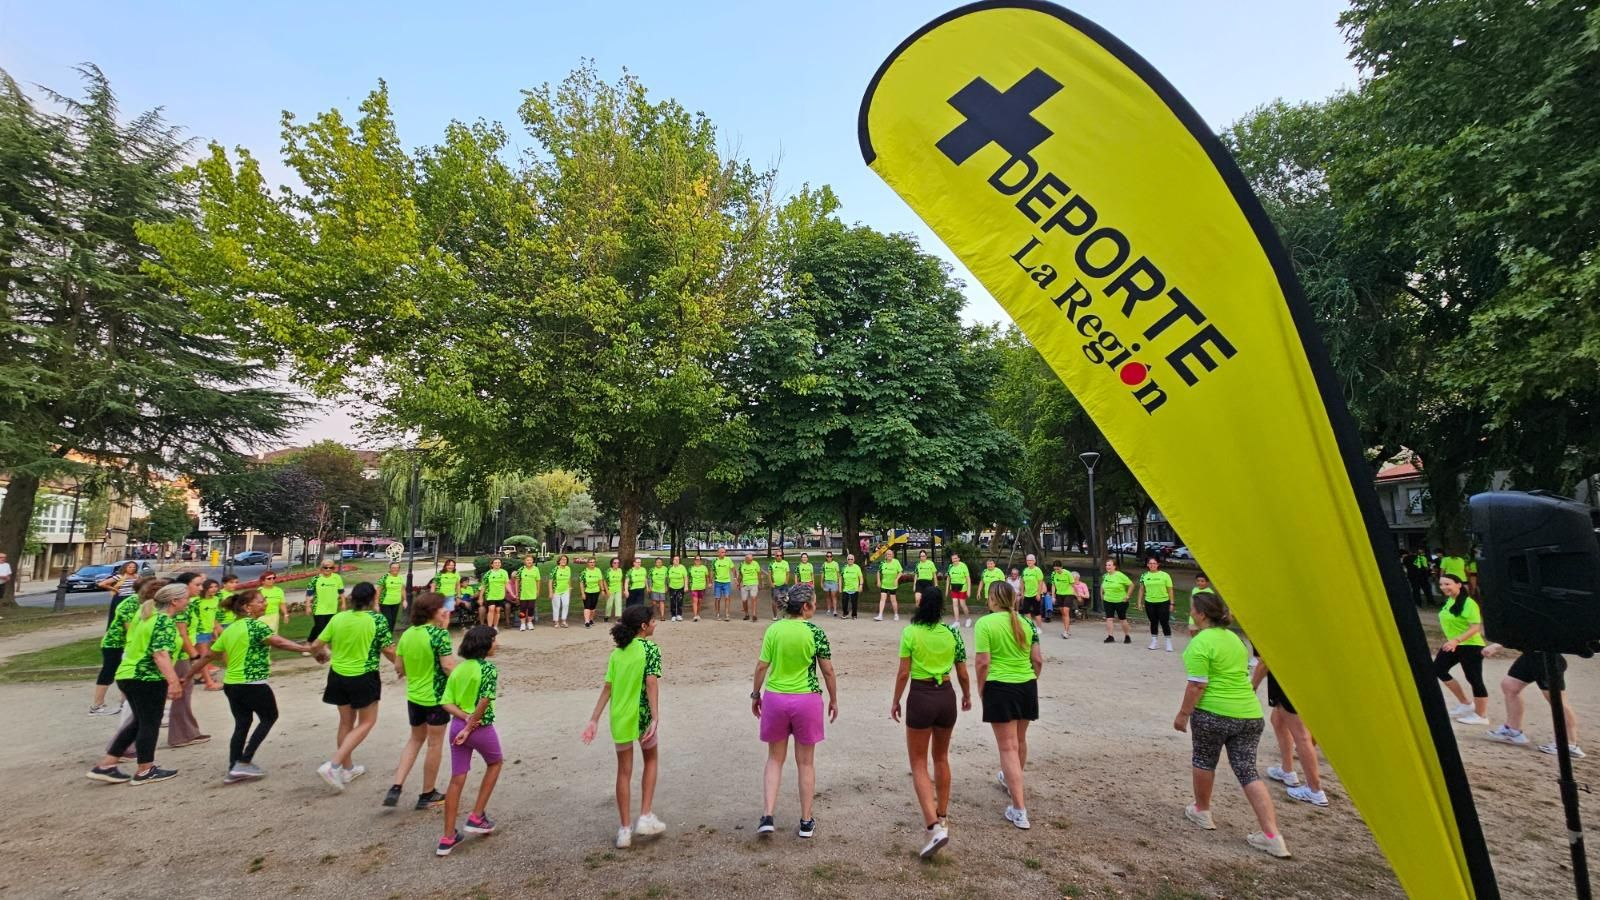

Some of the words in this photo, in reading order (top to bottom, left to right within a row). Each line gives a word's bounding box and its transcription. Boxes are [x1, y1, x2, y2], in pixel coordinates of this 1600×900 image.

[987, 152, 1238, 387] DEPORTE
[1010, 235, 1058, 289] La
[1051, 278, 1168, 415] Región
